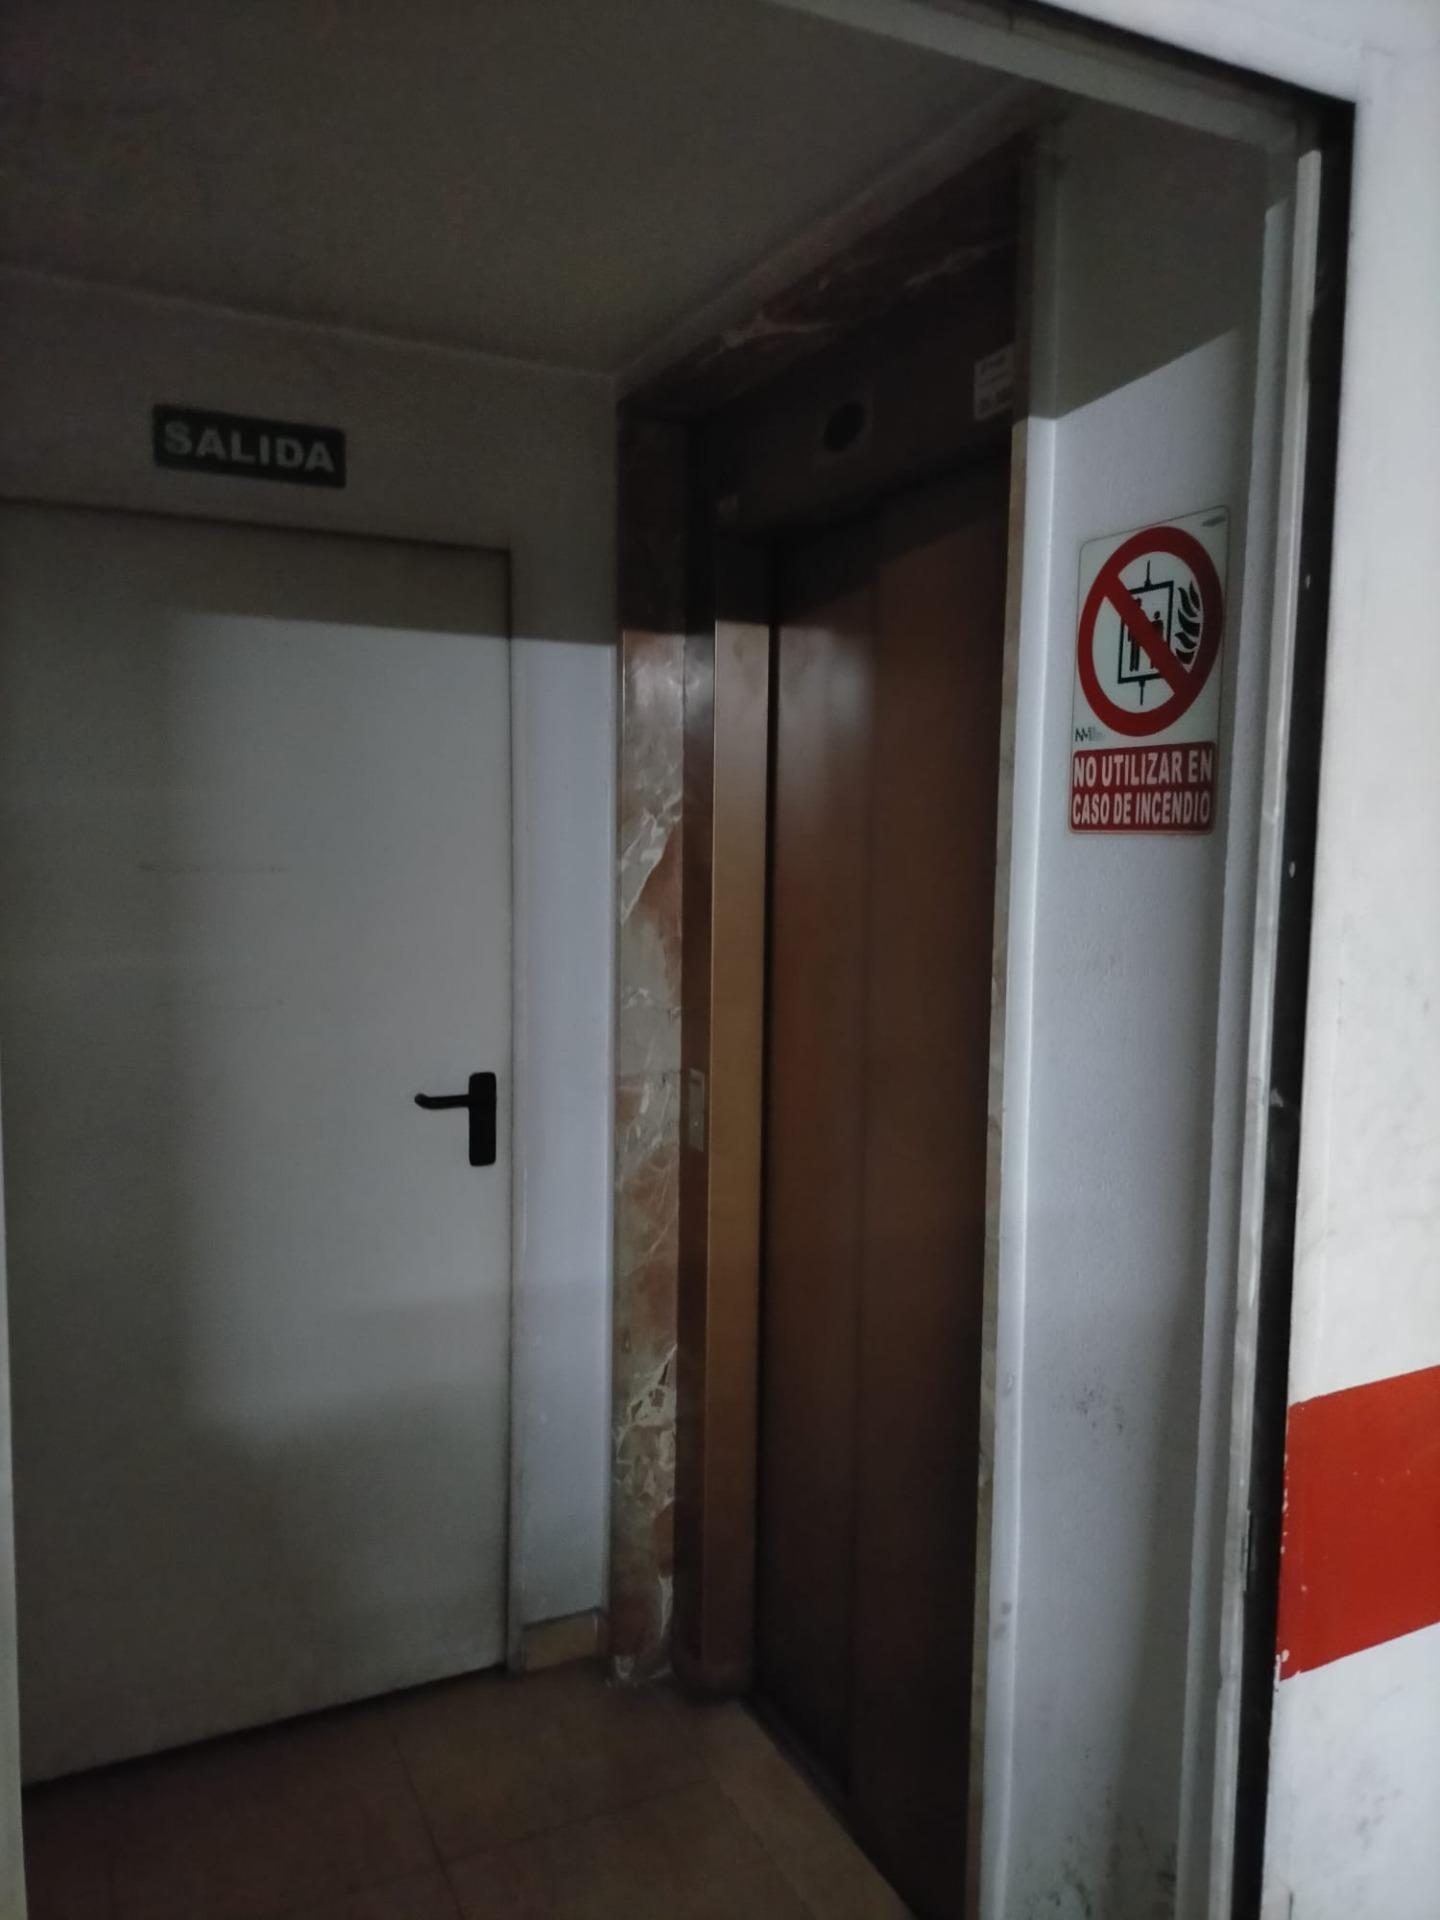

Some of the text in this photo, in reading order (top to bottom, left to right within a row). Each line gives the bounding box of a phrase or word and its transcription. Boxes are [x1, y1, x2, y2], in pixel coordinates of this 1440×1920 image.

[164, 420, 335, 472] SALIDA
[1074, 749, 1212, 787] NO UTILIZAR EN
[1073, 790, 1211, 825] CASO DE INCENDIO
